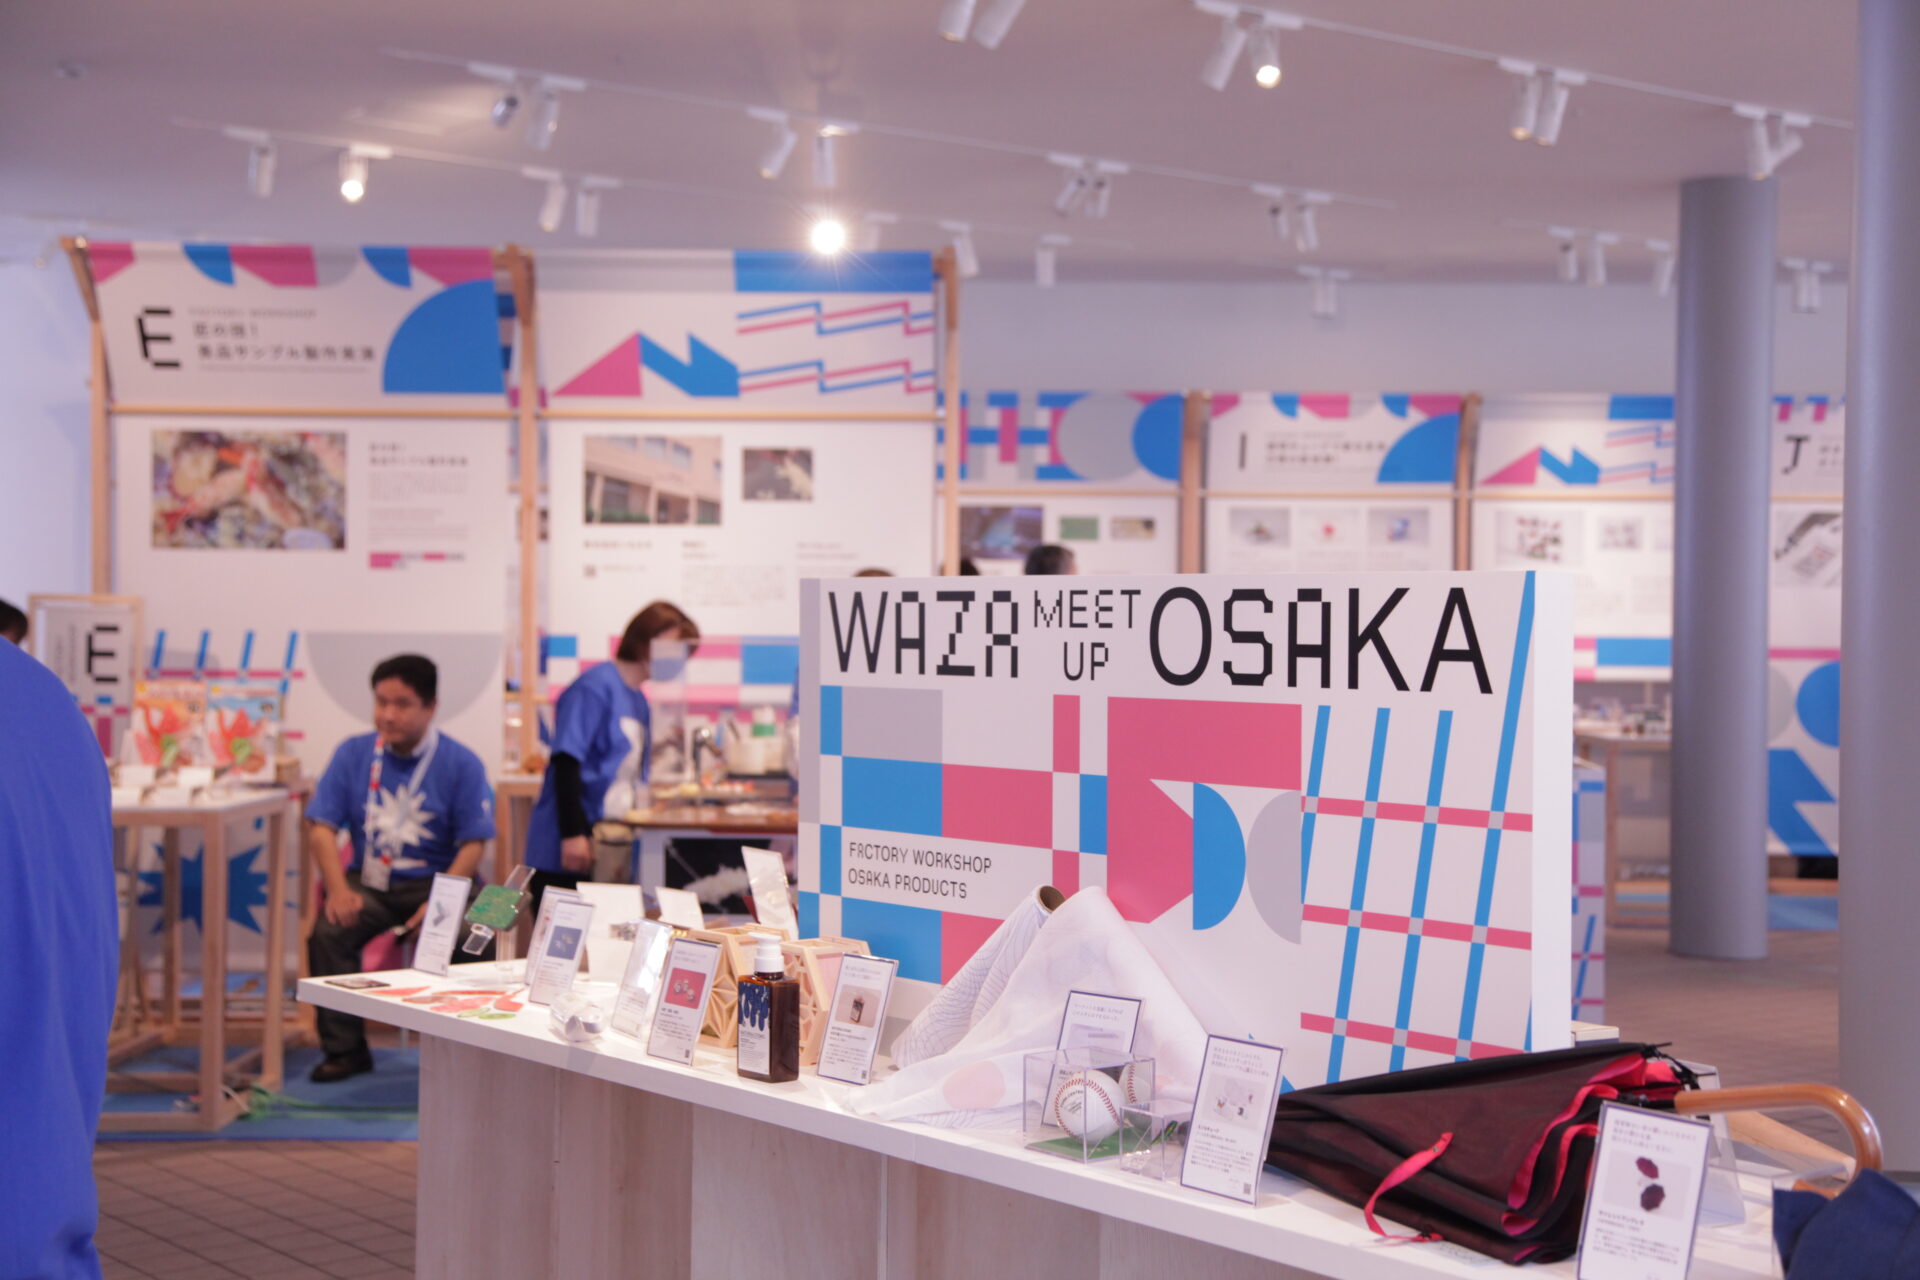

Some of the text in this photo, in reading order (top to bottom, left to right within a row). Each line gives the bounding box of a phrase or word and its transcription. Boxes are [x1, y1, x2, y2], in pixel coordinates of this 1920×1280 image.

[137, 308, 180, 369] E
[86, 625, 119, 684] E
[828, 586, 1494, 695] WAZA MEET UP OSAKA
[848, 867, 967, 899] OSAKA PRODUCTS
[849, 841, 992, 874] FACTORY WORKSHOP
